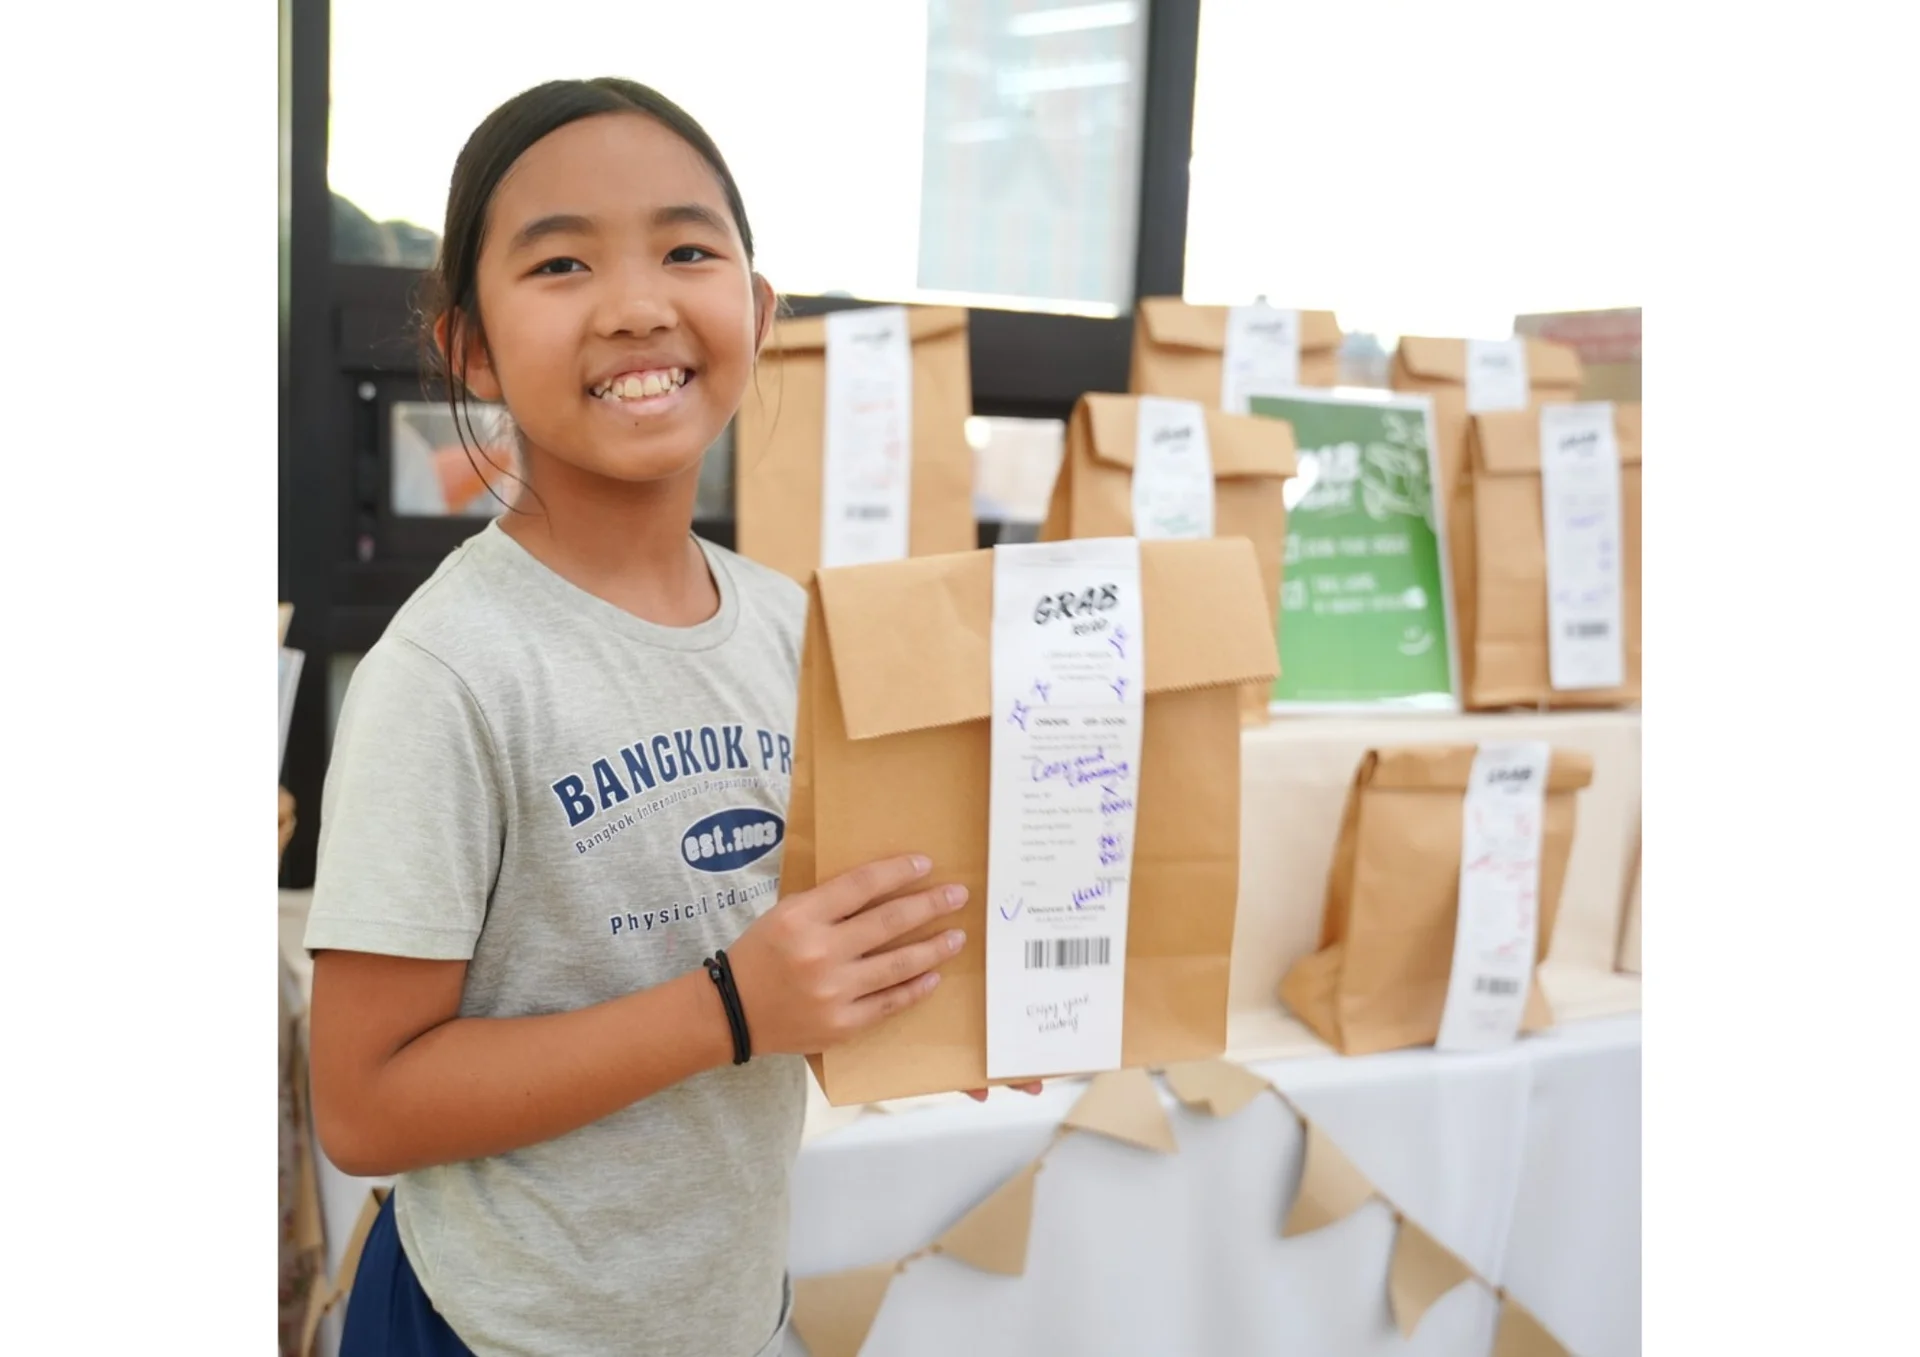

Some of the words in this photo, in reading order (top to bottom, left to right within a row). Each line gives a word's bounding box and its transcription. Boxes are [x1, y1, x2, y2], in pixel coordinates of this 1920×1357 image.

[1034, 582, 1119, 625] GRAB
[551, 724, 749, 828] BANGKOK
[575, 814, 635, 854] Bangkok
[637, 781, 702, 820] International
